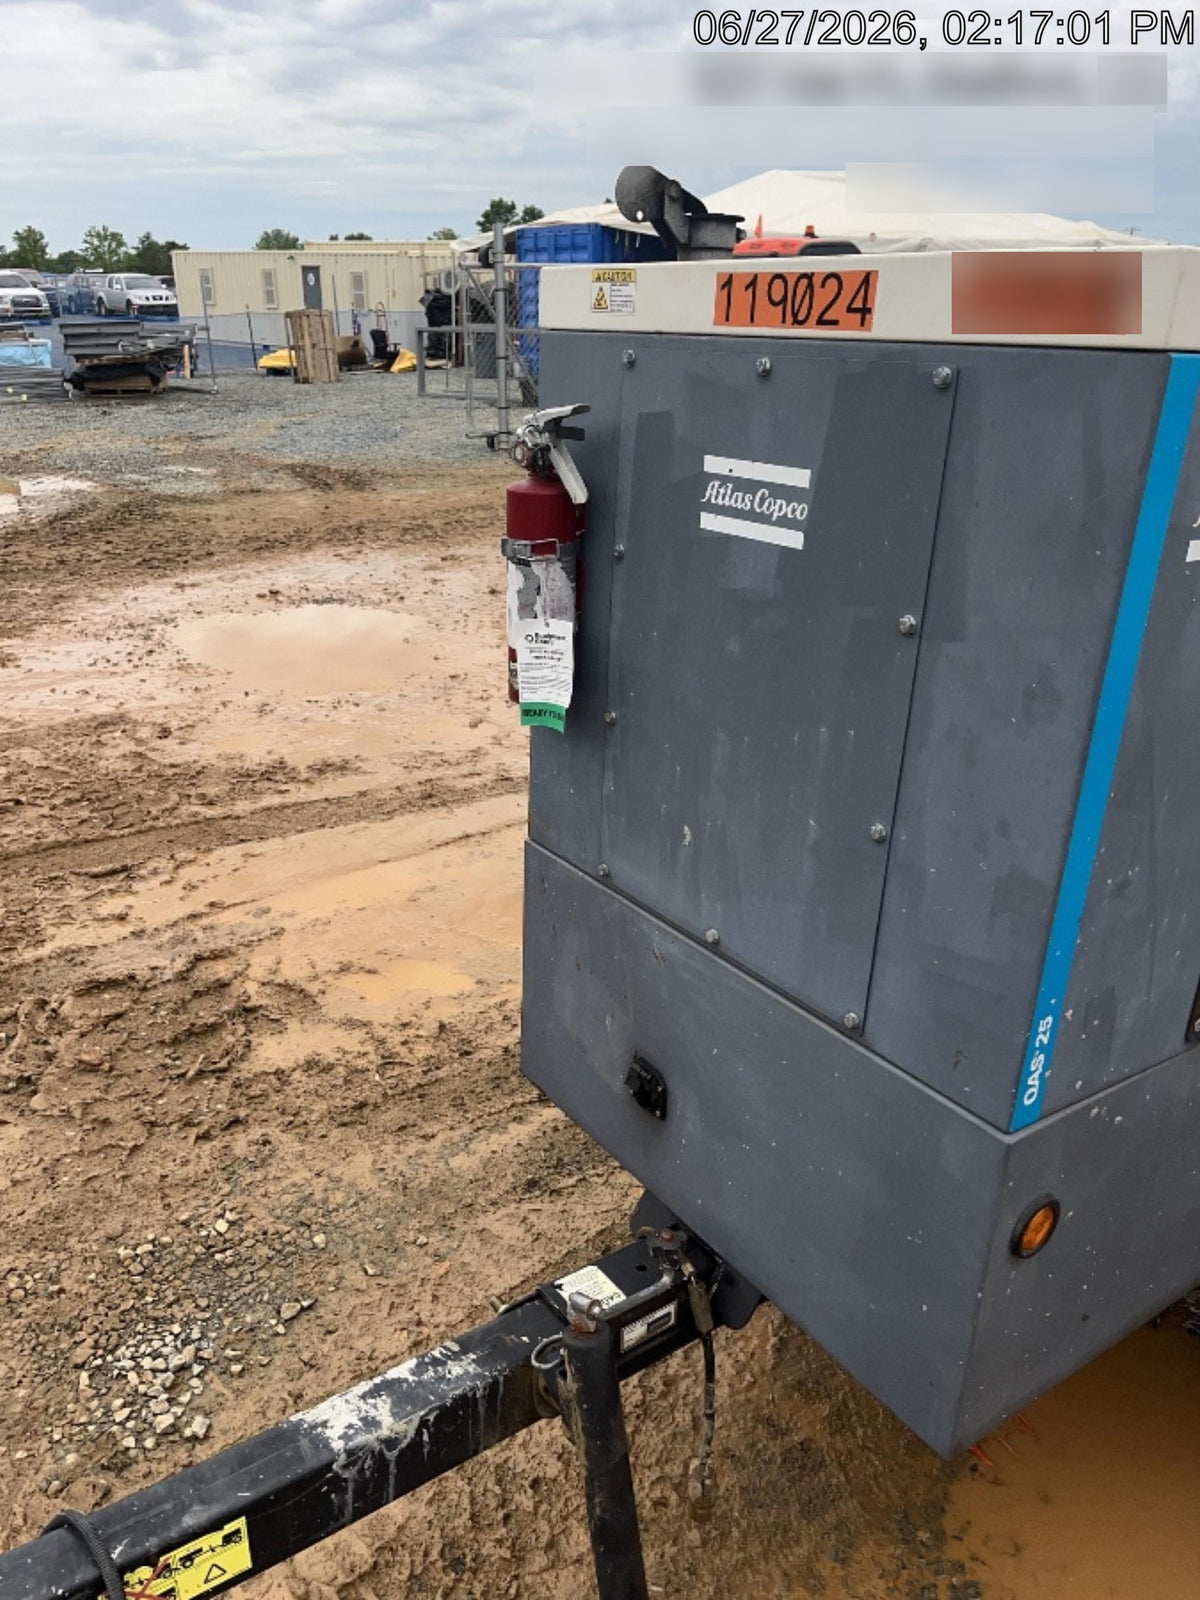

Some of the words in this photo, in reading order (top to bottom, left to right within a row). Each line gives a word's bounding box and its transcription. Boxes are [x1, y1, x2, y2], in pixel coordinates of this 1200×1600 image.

[700, 480, 753, 511] Atlas
[753, 488, 808, 522] Copco
[1023, 1053, 1045, 1106] OAS
[1035, 1015, 1053, 1048] 25
